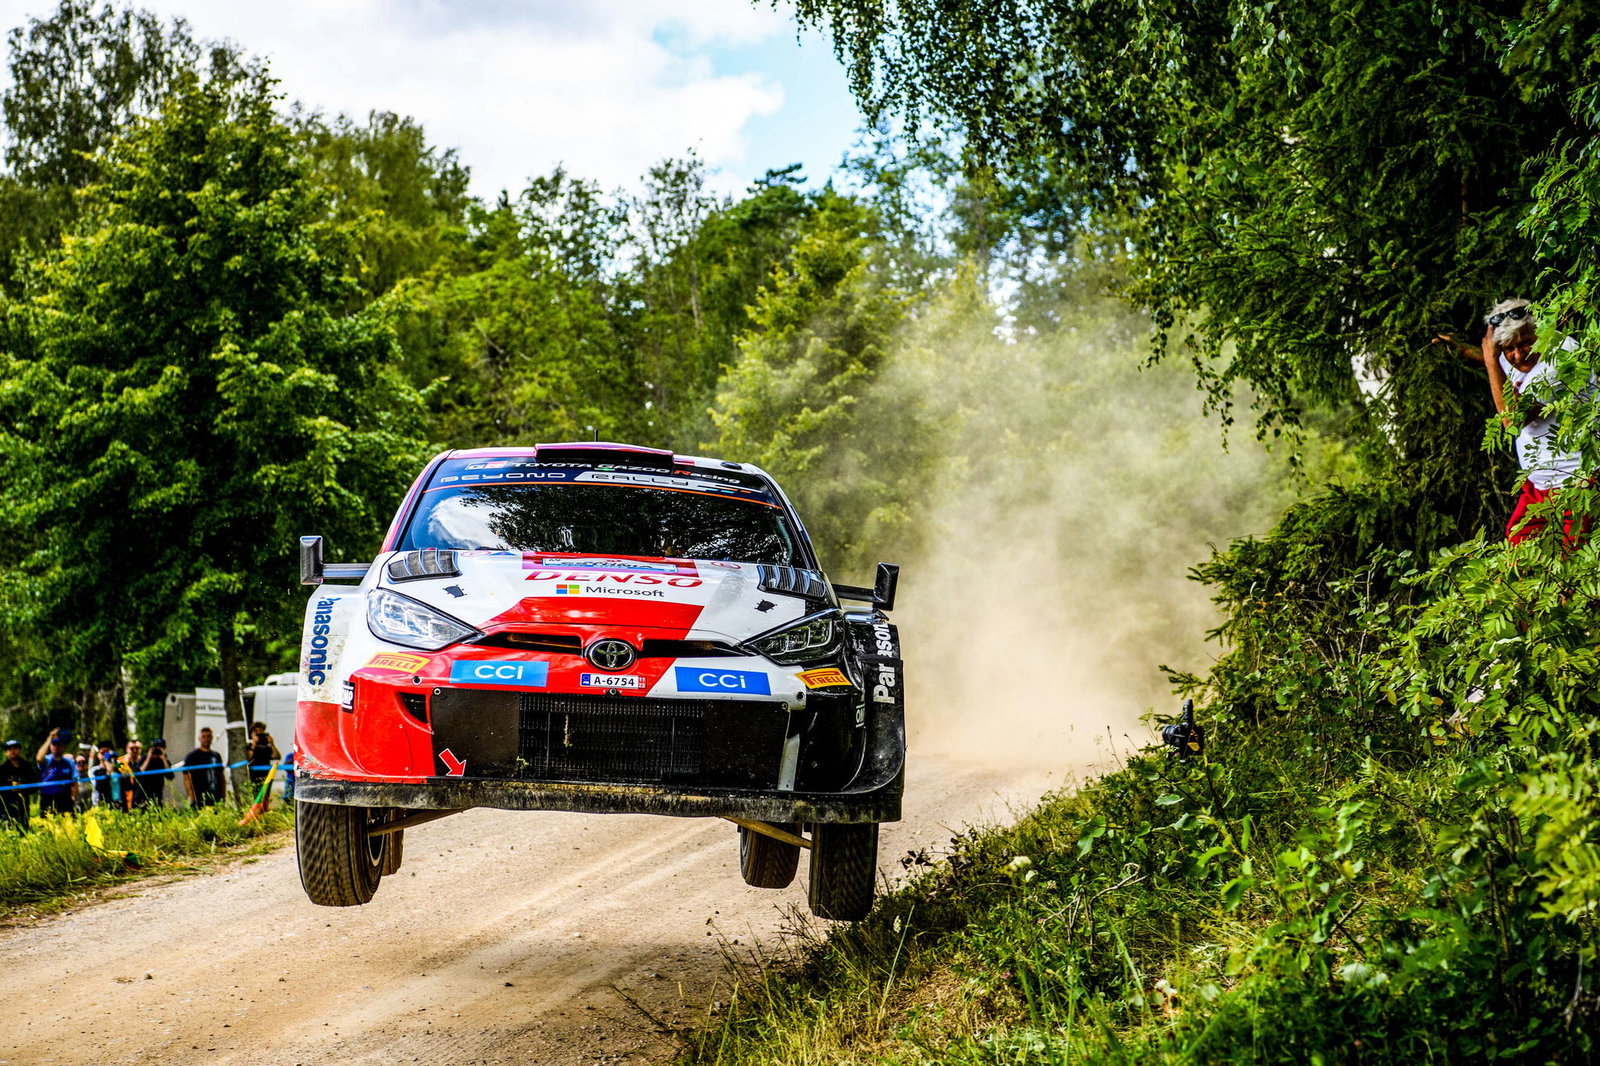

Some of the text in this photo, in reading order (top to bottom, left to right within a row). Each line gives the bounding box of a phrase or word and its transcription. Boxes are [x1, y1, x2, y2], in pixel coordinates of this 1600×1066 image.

[440, 472, 566, 483] BEYOND
[598, 463, 670, 474] GAZOO
[673, 469, 741, 484] Racing
[525, 571, 703, 588] DENSO
[586, 586, 665, 598] Microsoft
[368, 654, 423, 670] PIRELLI
[594, 676, 635, 687] A-6754
[801, 670, 847, 686] PIRELLI
